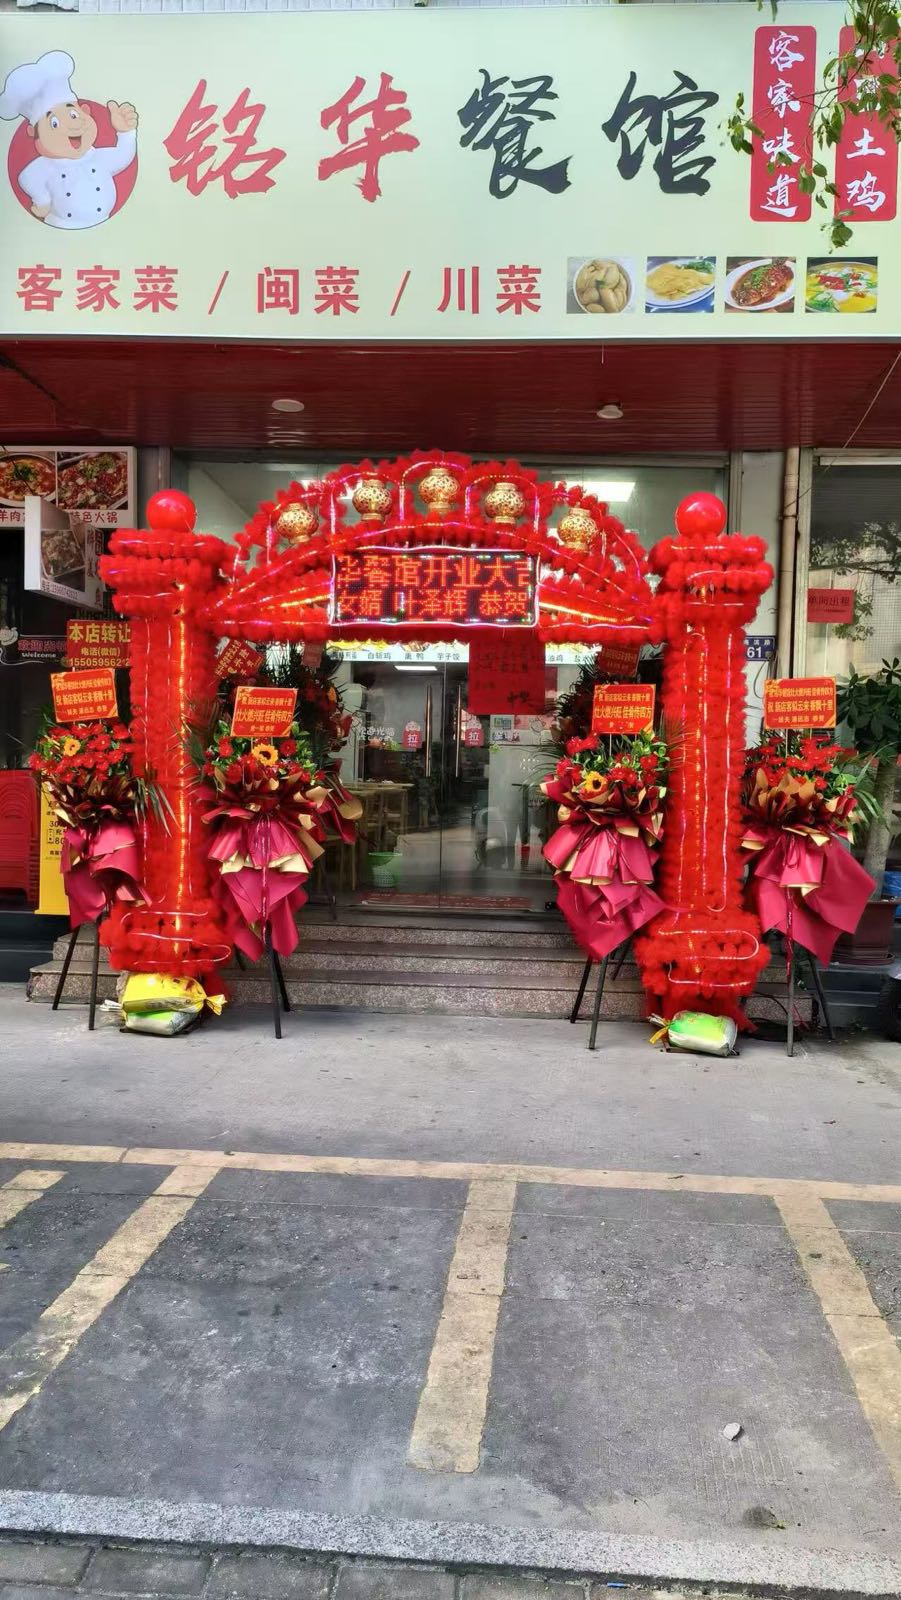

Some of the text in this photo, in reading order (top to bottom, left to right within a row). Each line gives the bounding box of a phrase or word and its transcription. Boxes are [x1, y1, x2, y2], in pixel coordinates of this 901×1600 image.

[163, 68, 720, 202] 铭华餐馆
[760, 30, 805, 218] 客家味道
[16, 264, 542, 316] 客家菜 闽菜 川菜
[0, 511, 25, 522] 羊肉
[338, 589, 527, 616] 女婿 叶泽辉 恭贺
[69, 623, 131, 643] 本店转让
[407, 734, 418, 742] 拉
[469, 731, 480, 741] 拉
